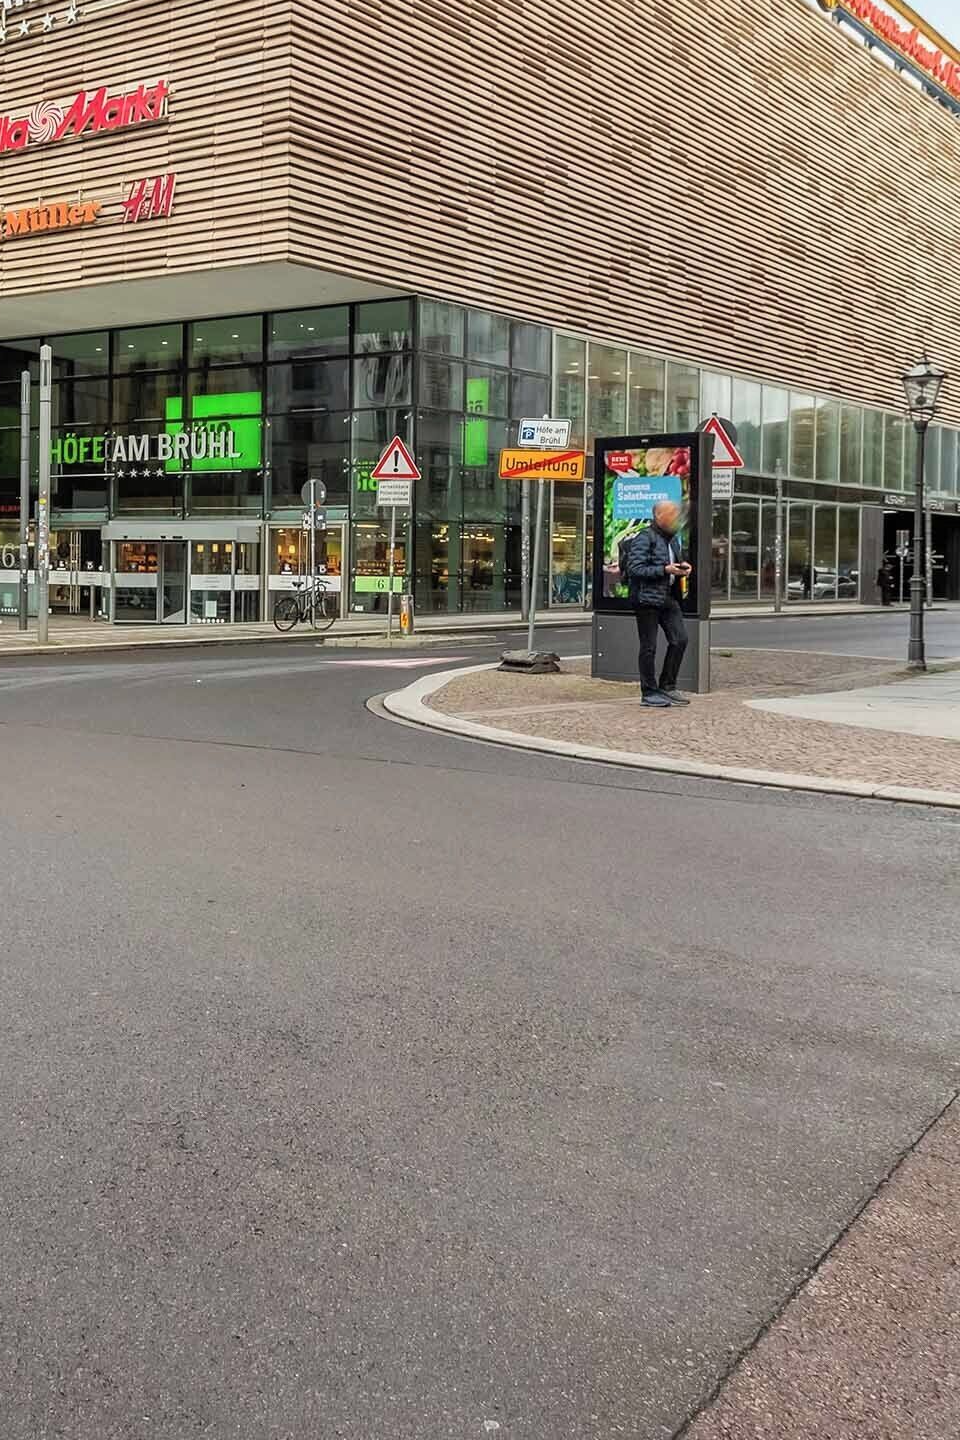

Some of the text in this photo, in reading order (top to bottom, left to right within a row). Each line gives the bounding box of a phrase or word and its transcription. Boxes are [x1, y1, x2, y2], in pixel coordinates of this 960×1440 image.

[55, 79, 168, 140] Markt
[121, 173, 177, 224] H&M
[5, 200, 102, 237] Müller
[49, 433, 106, 464] HÖFE
[112, 435, 150, 462] AM
[158, 424, 242, 461] BRÜHL
[536, 425, 553, 434] Höfe
[540, 436, 560, 444] Brühl
[506, 458, 578, 476] Umleitung
[2, 543, 15, 568] 6
